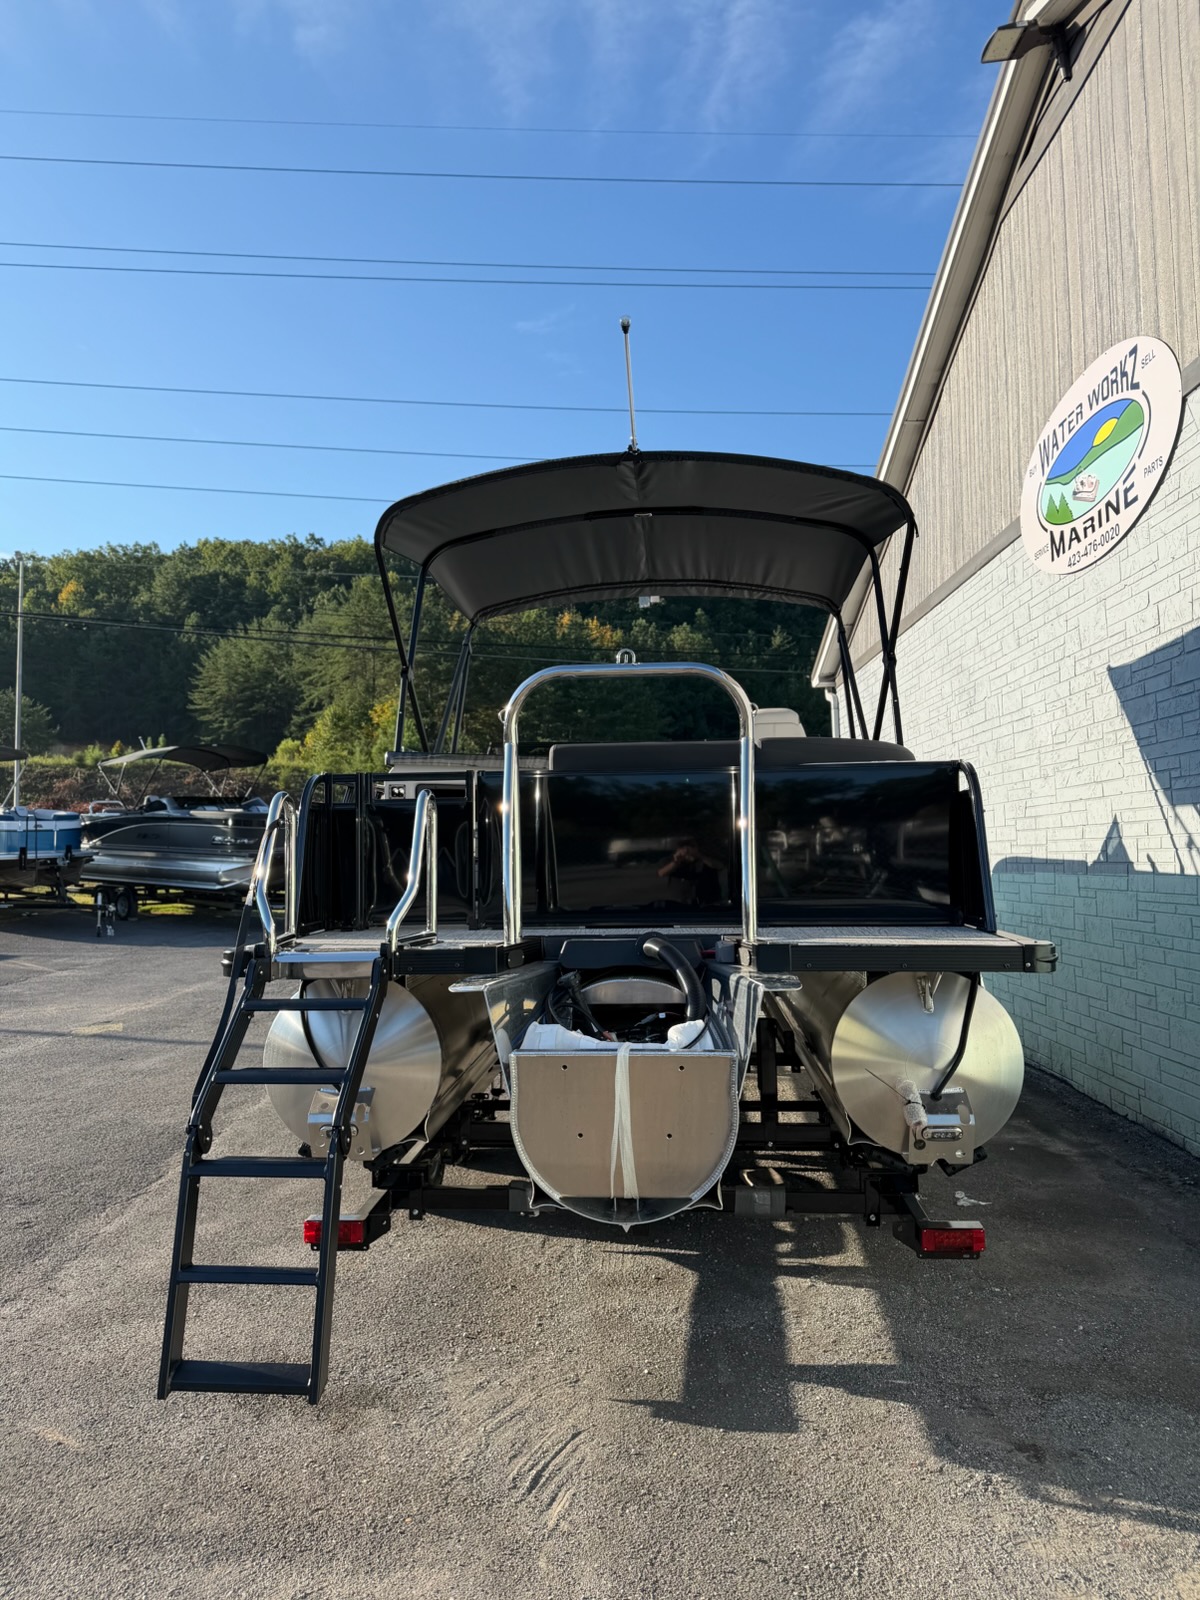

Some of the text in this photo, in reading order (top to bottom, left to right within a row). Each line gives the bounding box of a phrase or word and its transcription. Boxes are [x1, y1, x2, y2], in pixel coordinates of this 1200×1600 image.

[1140, 349, 1156, 369] SELL
[1039, 343, 1140, 477] WATER WORKZ
[1143, 456, 1164, 478] PARTS
[1049, 463, 1139, 562] MARINE
[1067, 523, 1120, 568] 423-476-0020
